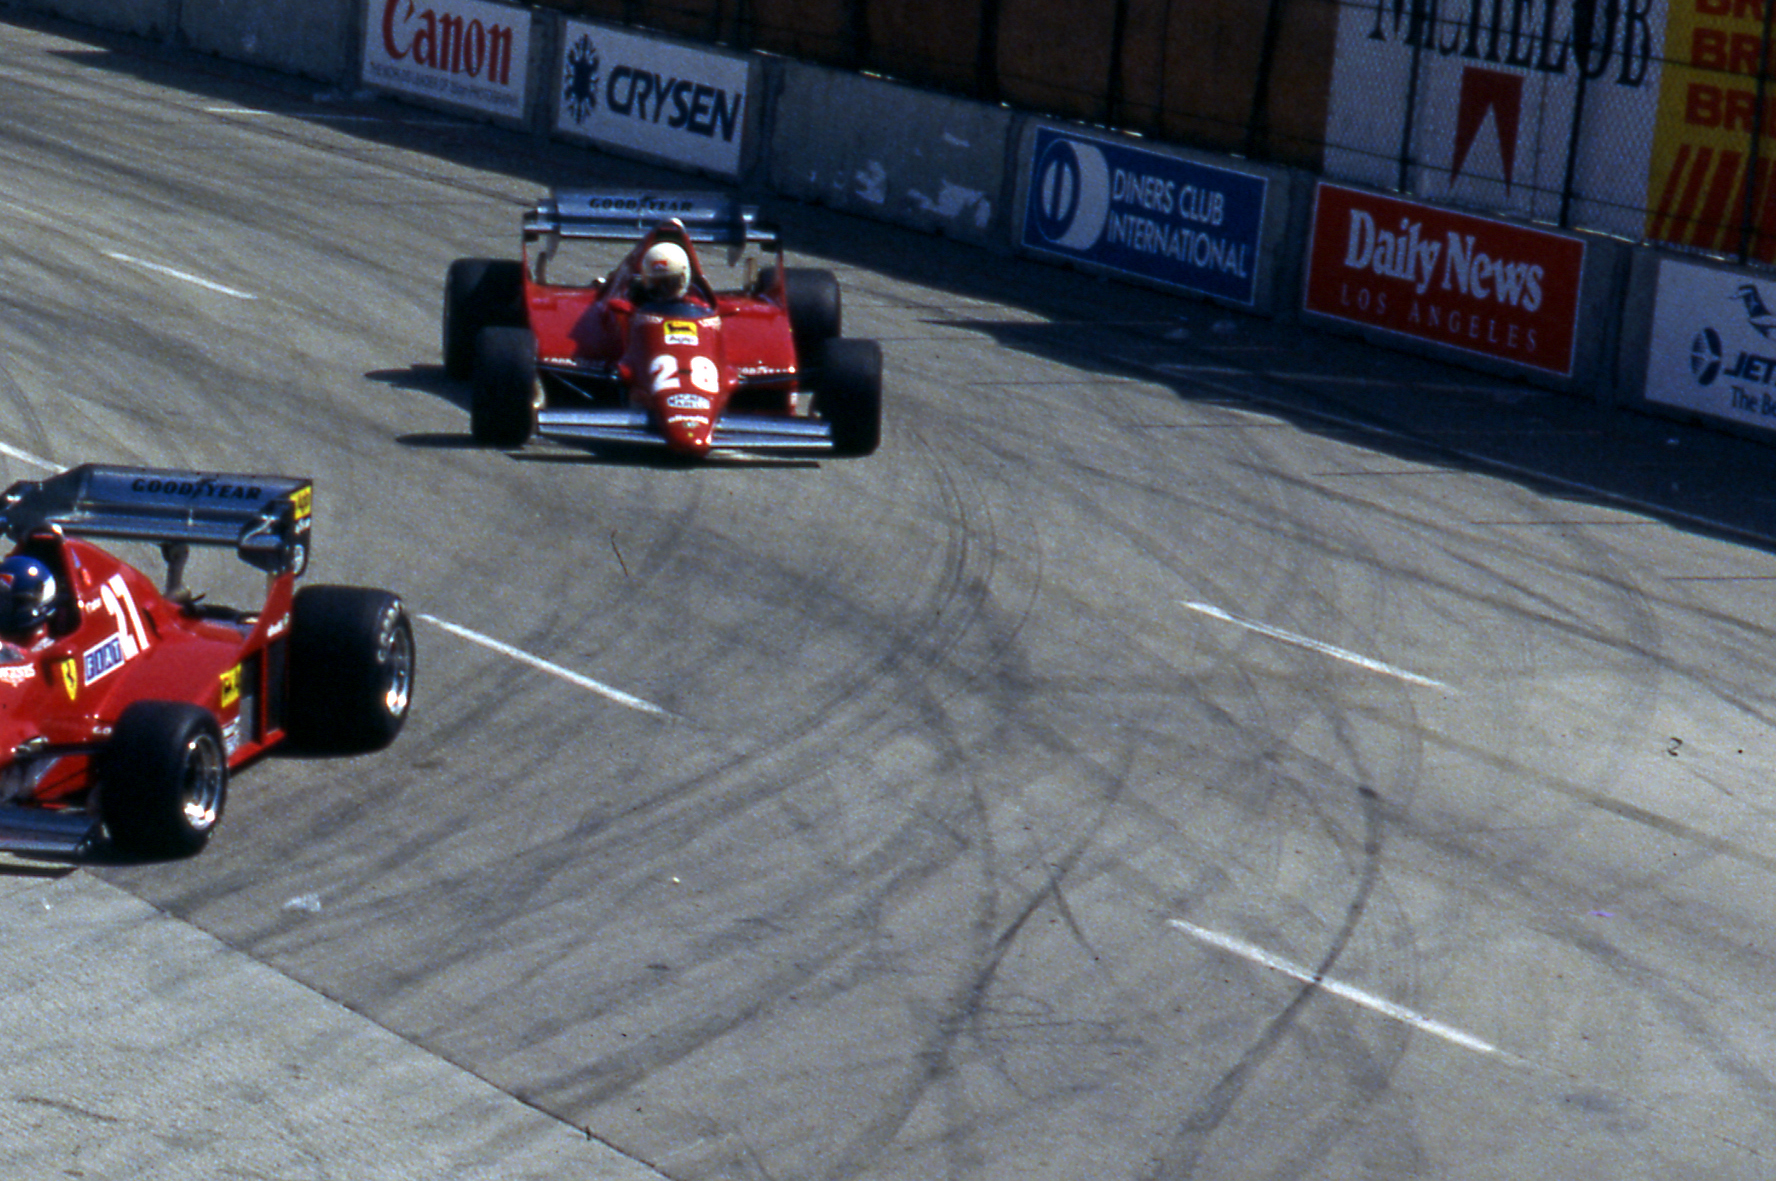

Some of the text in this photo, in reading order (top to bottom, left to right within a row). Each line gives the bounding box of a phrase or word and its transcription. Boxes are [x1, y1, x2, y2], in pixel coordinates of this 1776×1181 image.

[606, 65, 742, 142] CRYSEN
[589, 196, 694, 212] GOODYEAR
[1112, 168, 1223, 227] DINERS CLUB
[1107, 213, 1247, 280] INTERNATIONAL
[1344, 209, 1545, 312] Daily News
[1340, 281, 1540, 353] LOS ANGELES
[649, 353, 719, 394] 28
[1731, 385, 1758, 413] The
[131, 479, 262, 501] GOODYEAR
[86, 636, 123, 678] FIAT
